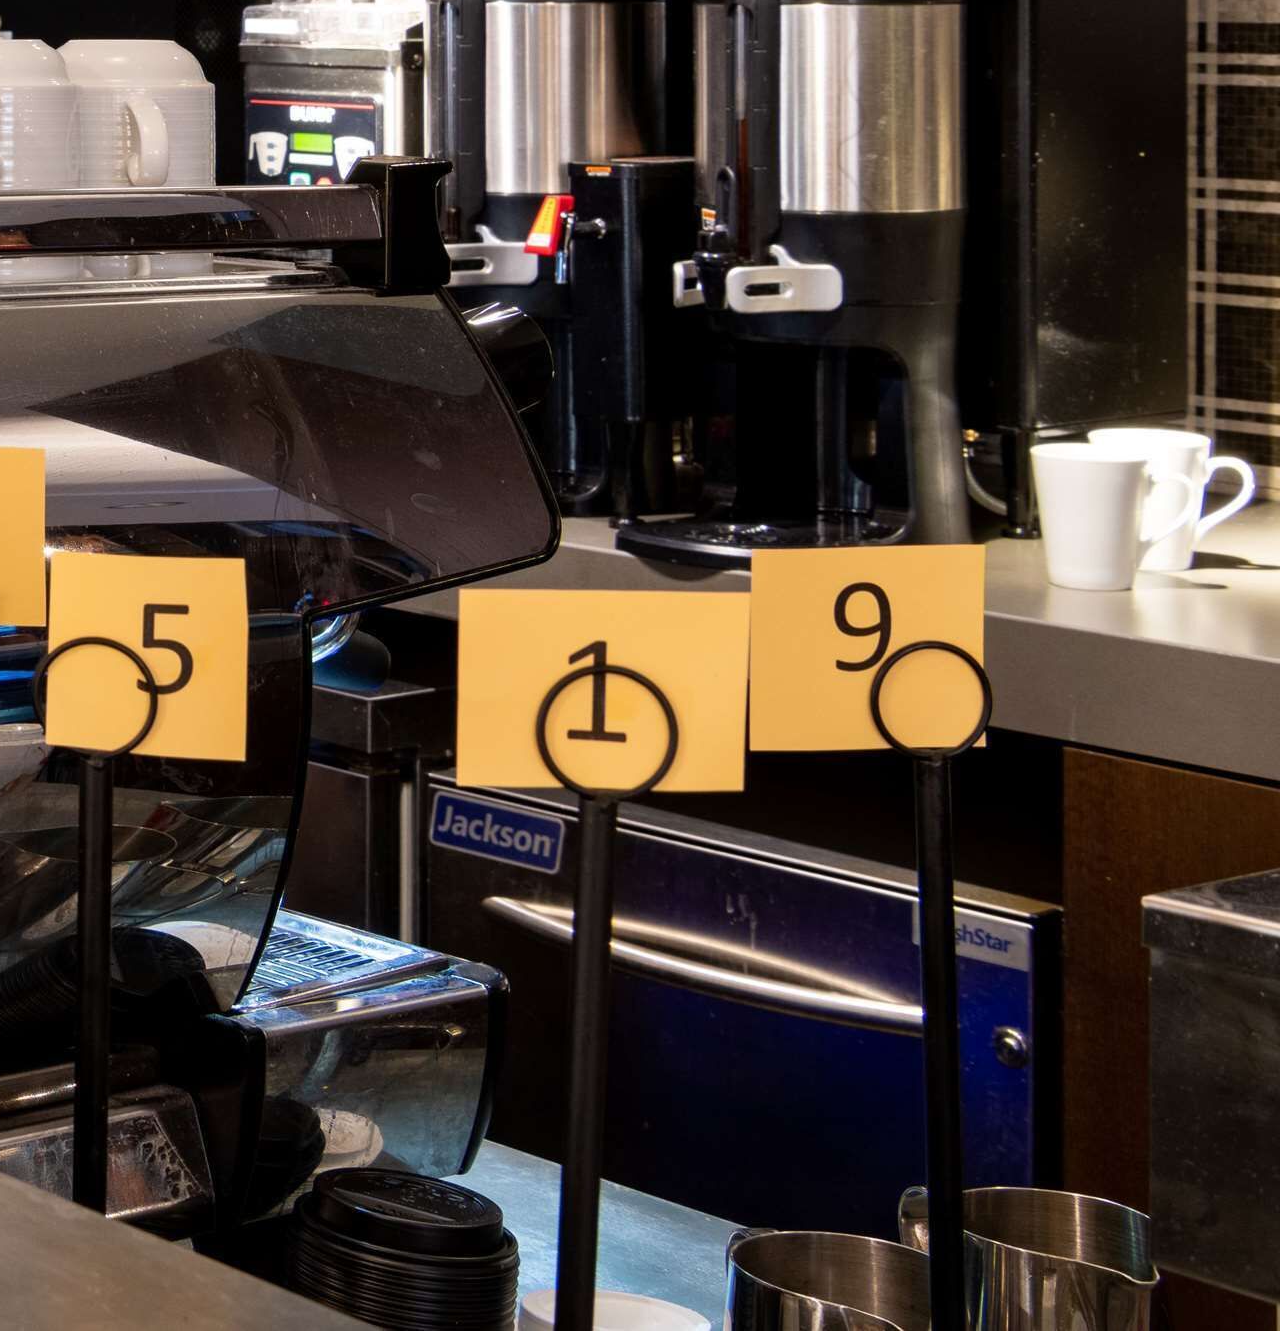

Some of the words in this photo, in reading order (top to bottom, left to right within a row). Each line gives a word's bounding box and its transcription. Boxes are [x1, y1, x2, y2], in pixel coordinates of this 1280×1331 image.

[135, 603, 195, 696] 5
[832, 581, 893, 672] 9
[566, 641, 628, 743] 1
[438, 805, 552, 858] Jackson
[955, 924, 1012, 954] shStar
